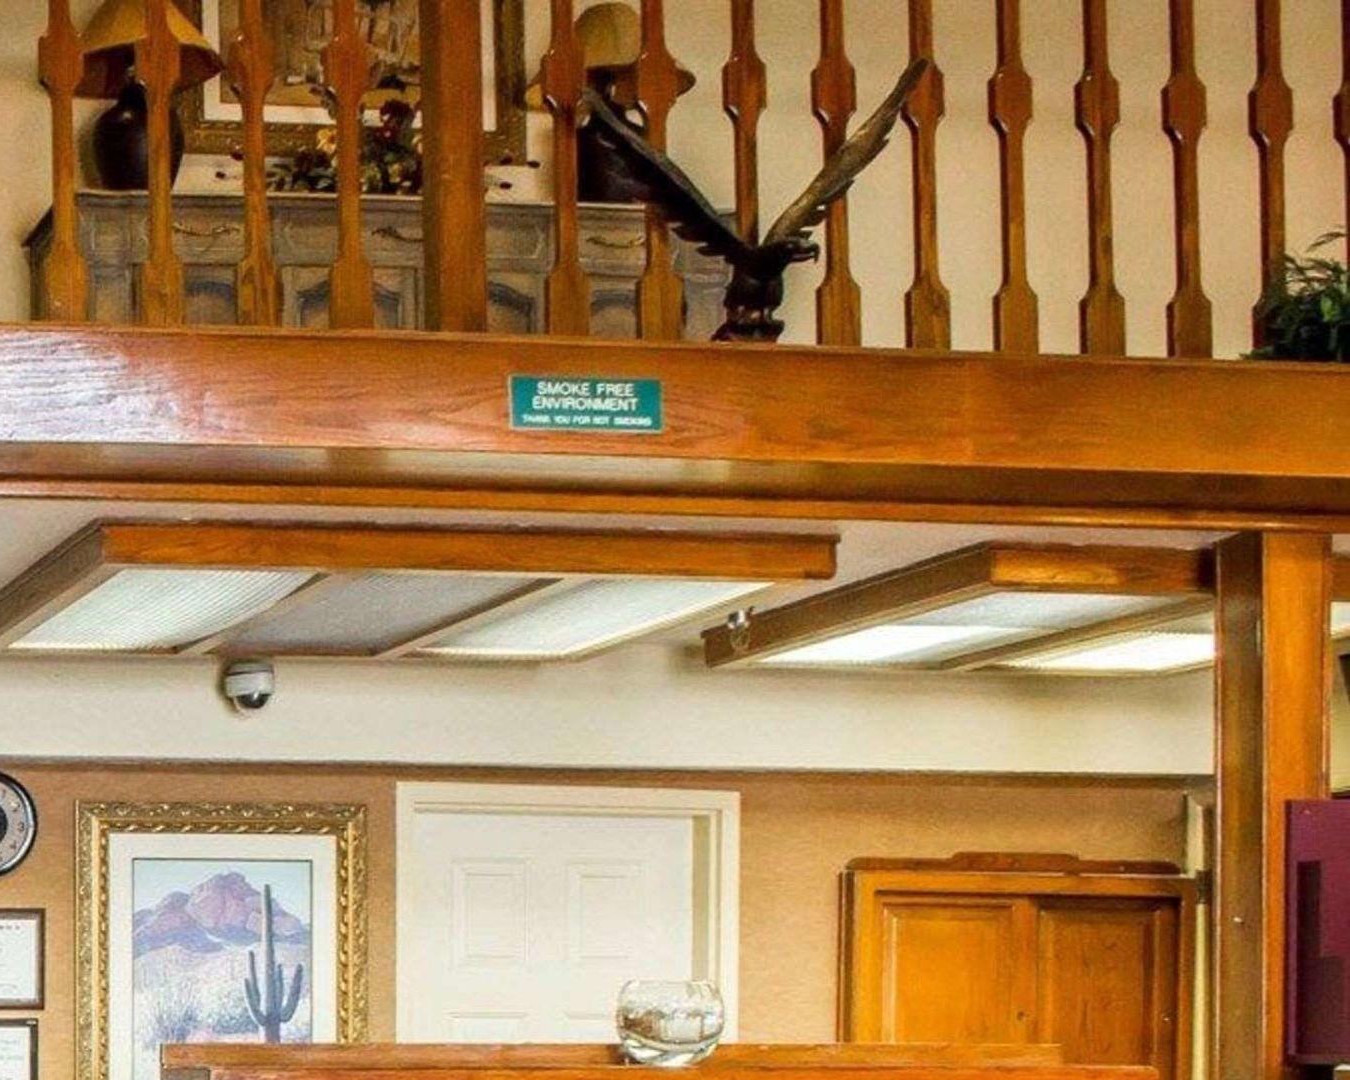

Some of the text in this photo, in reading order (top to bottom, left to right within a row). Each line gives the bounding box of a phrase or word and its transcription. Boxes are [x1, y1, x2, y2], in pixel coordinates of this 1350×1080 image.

[536, 381, 635, 397] SMOKE FREE
[532, 396, 639, 411] ENVIRONMENT
[554, 415, 570, 424] YOU
[573, 415, 591, 425] FOR
